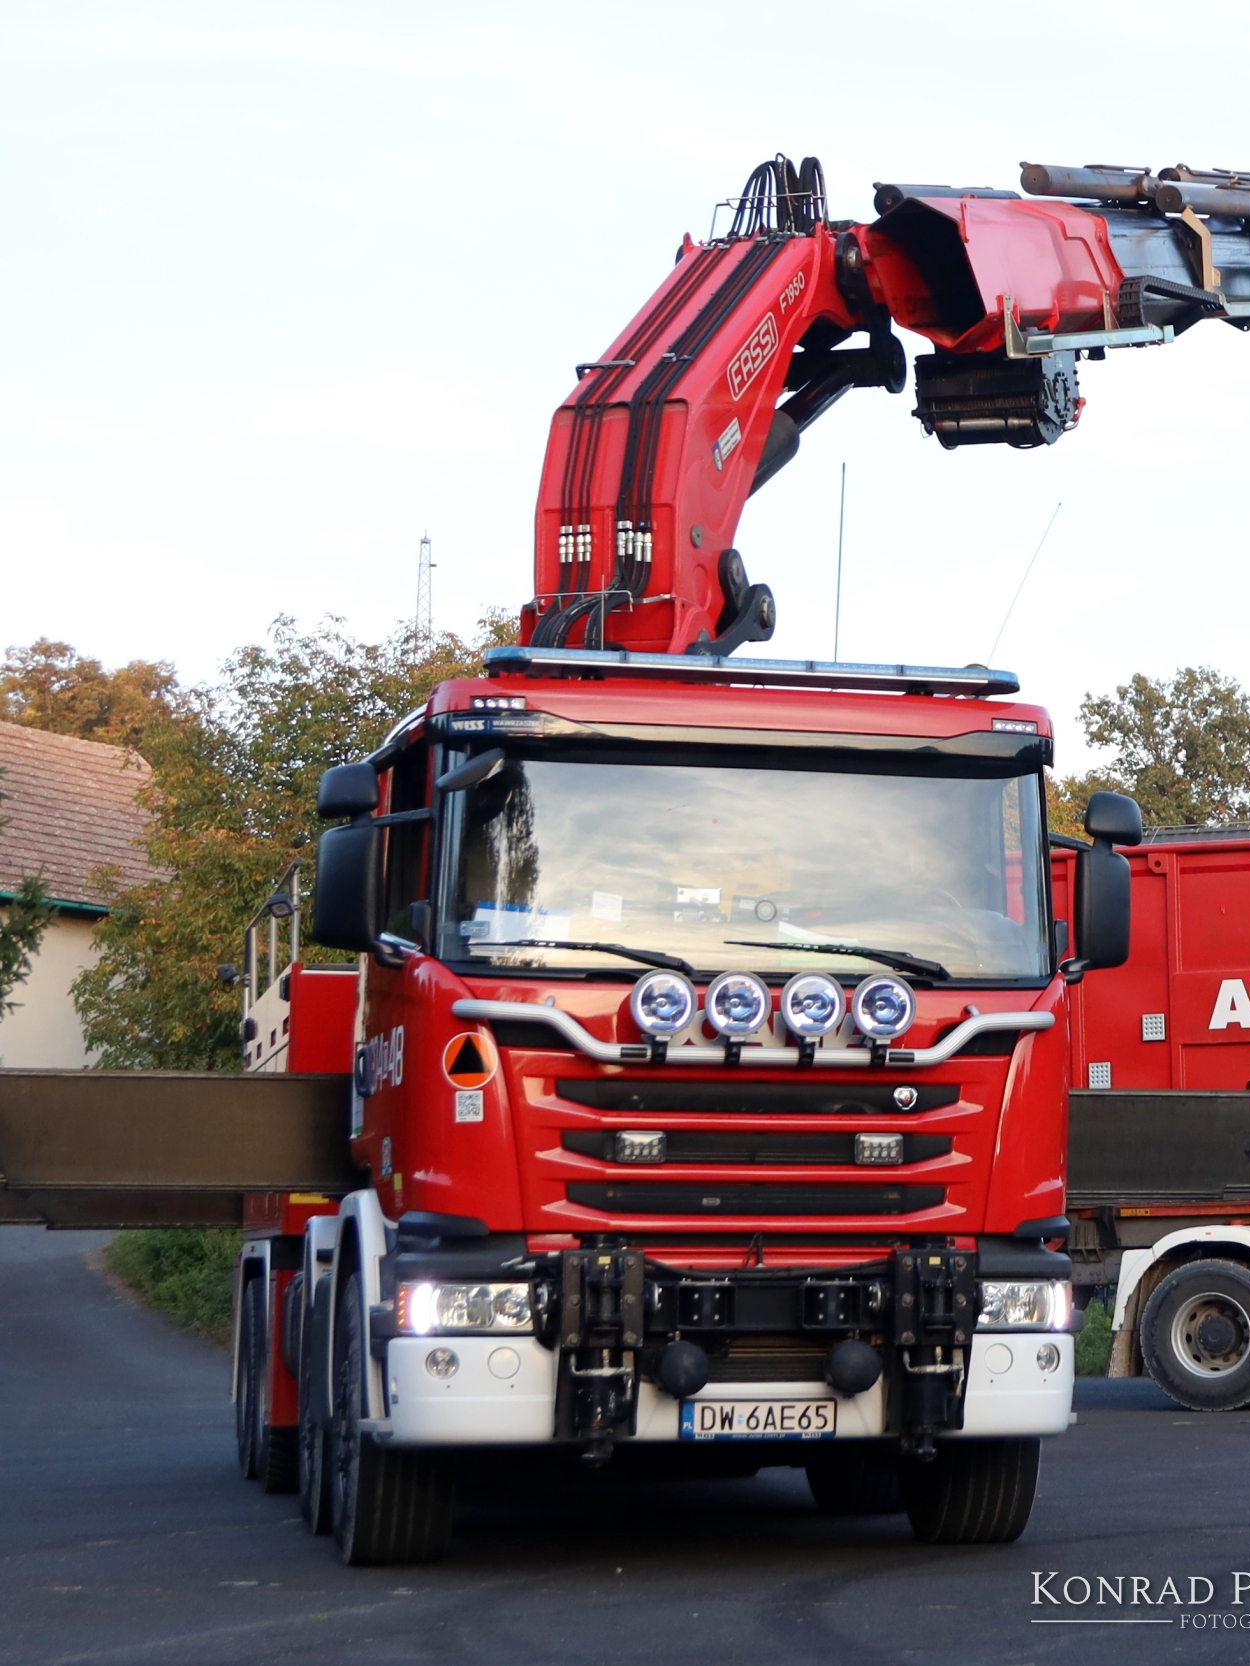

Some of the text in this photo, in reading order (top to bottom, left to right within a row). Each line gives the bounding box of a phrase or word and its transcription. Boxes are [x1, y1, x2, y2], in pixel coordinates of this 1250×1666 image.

[779, 271, 805, 314] F1950
[729, 318, 776, 394] FASSI
[451, 719, 485, 731] WISS
[683, 1405, 828, 1431] PL DW 6AE65
